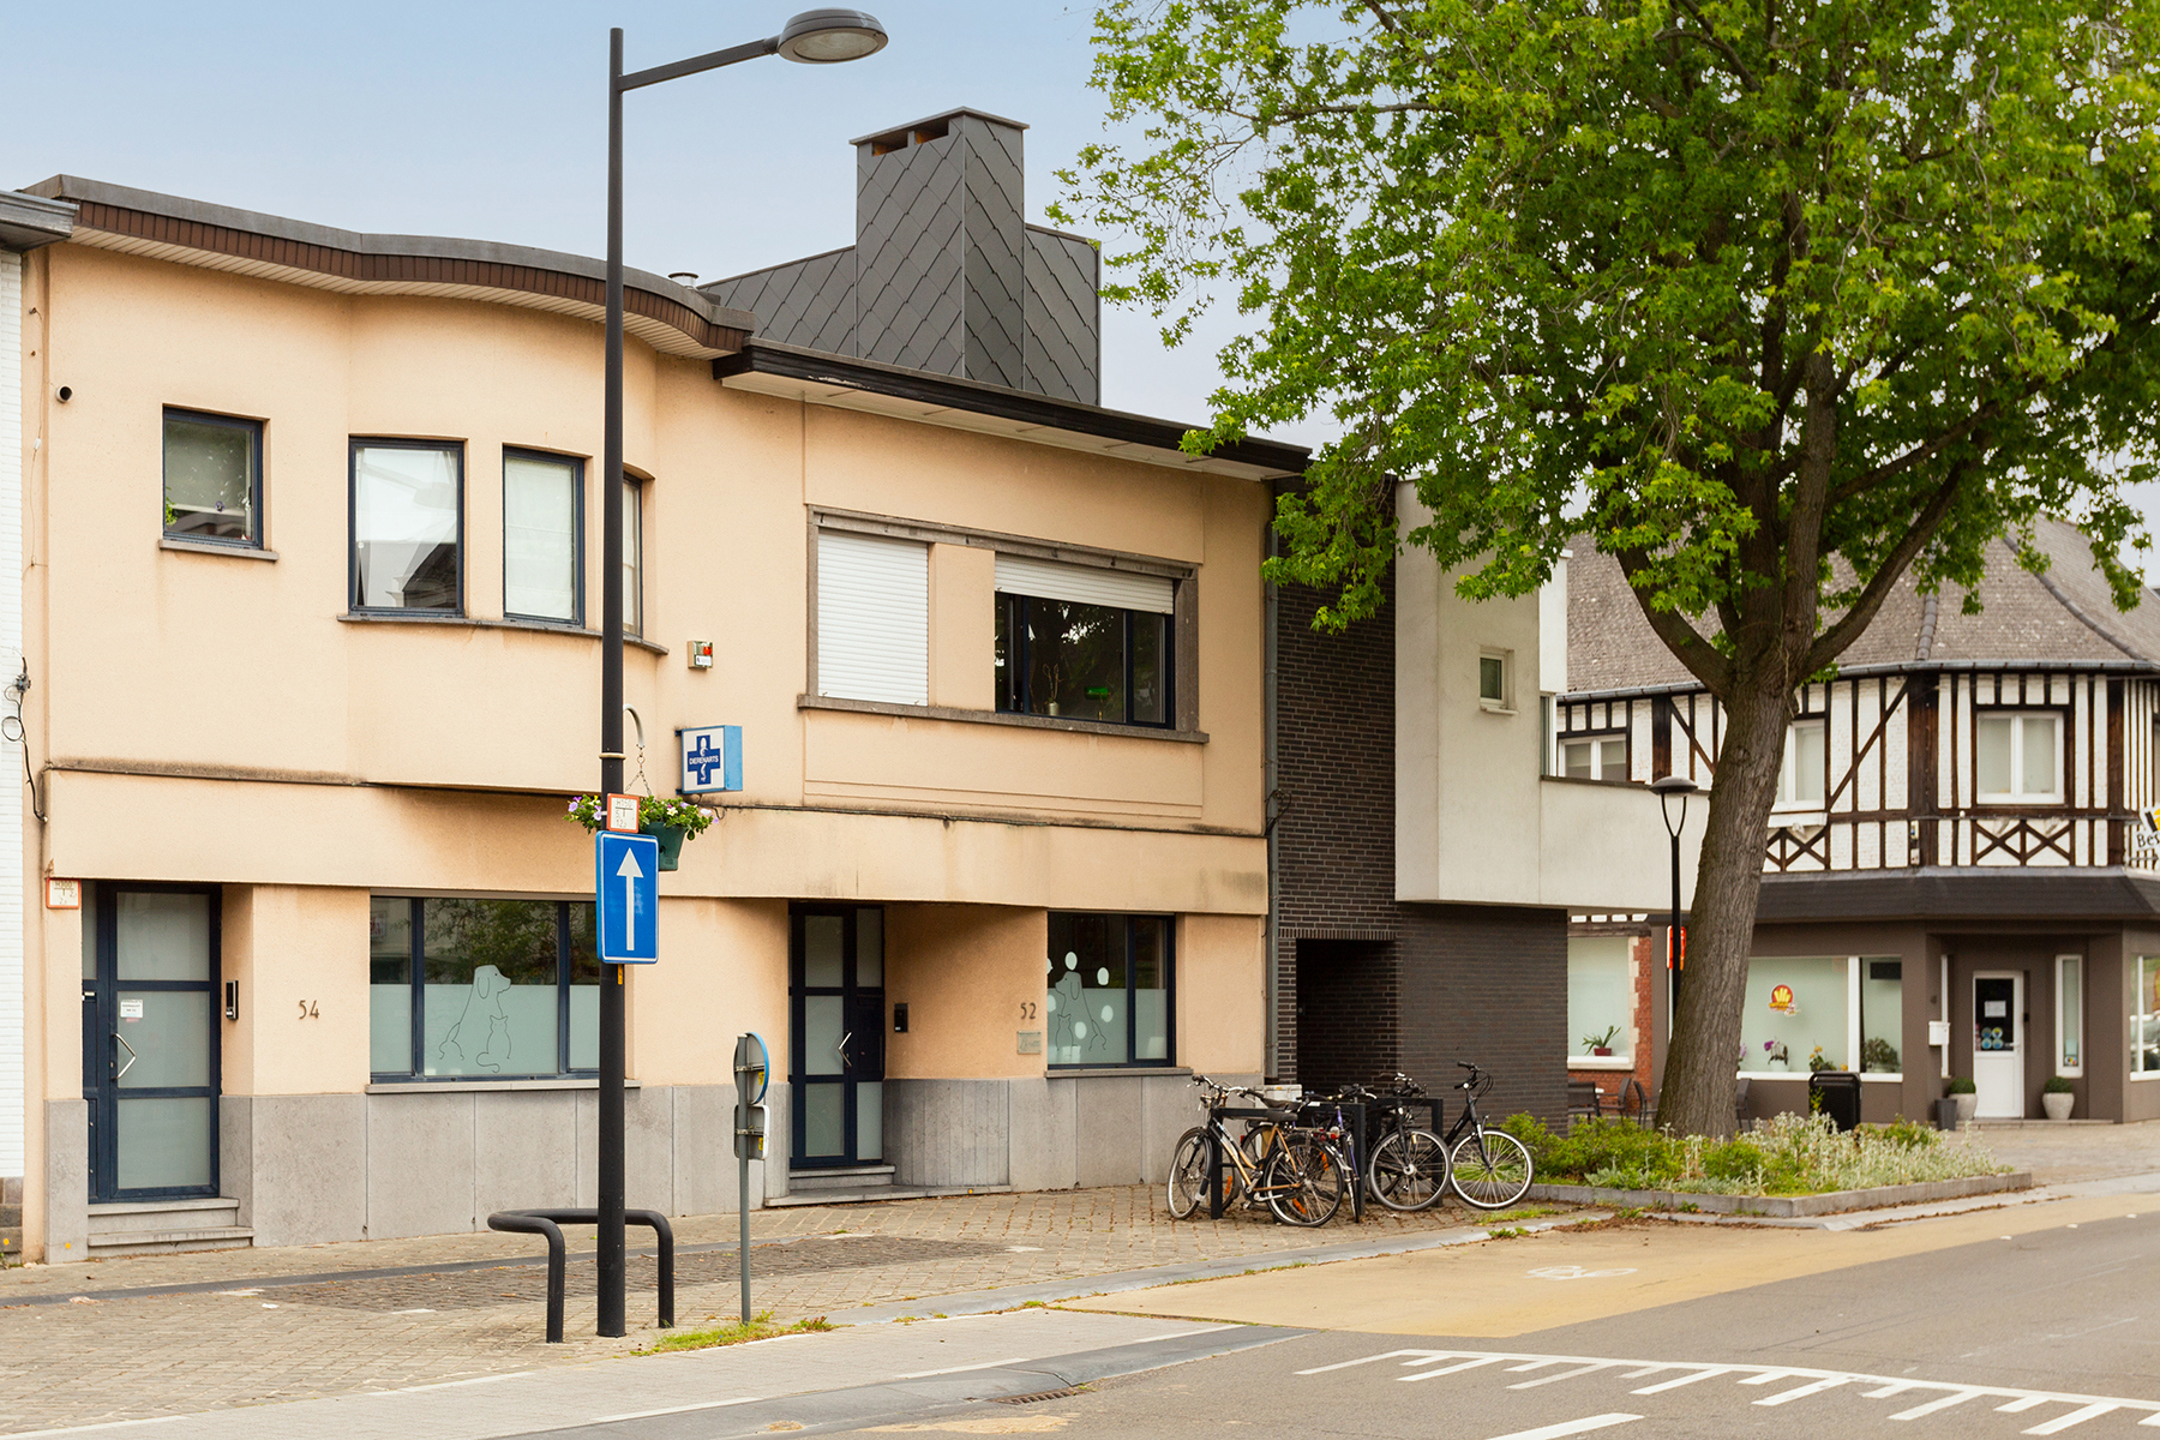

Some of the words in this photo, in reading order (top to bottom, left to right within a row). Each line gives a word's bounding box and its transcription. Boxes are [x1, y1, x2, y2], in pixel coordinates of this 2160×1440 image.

[689, 755, 719, 765] DIERENARTS
[298, 999, 320, 1020] 54
[1020, 1002, 1037, 1020] 52
